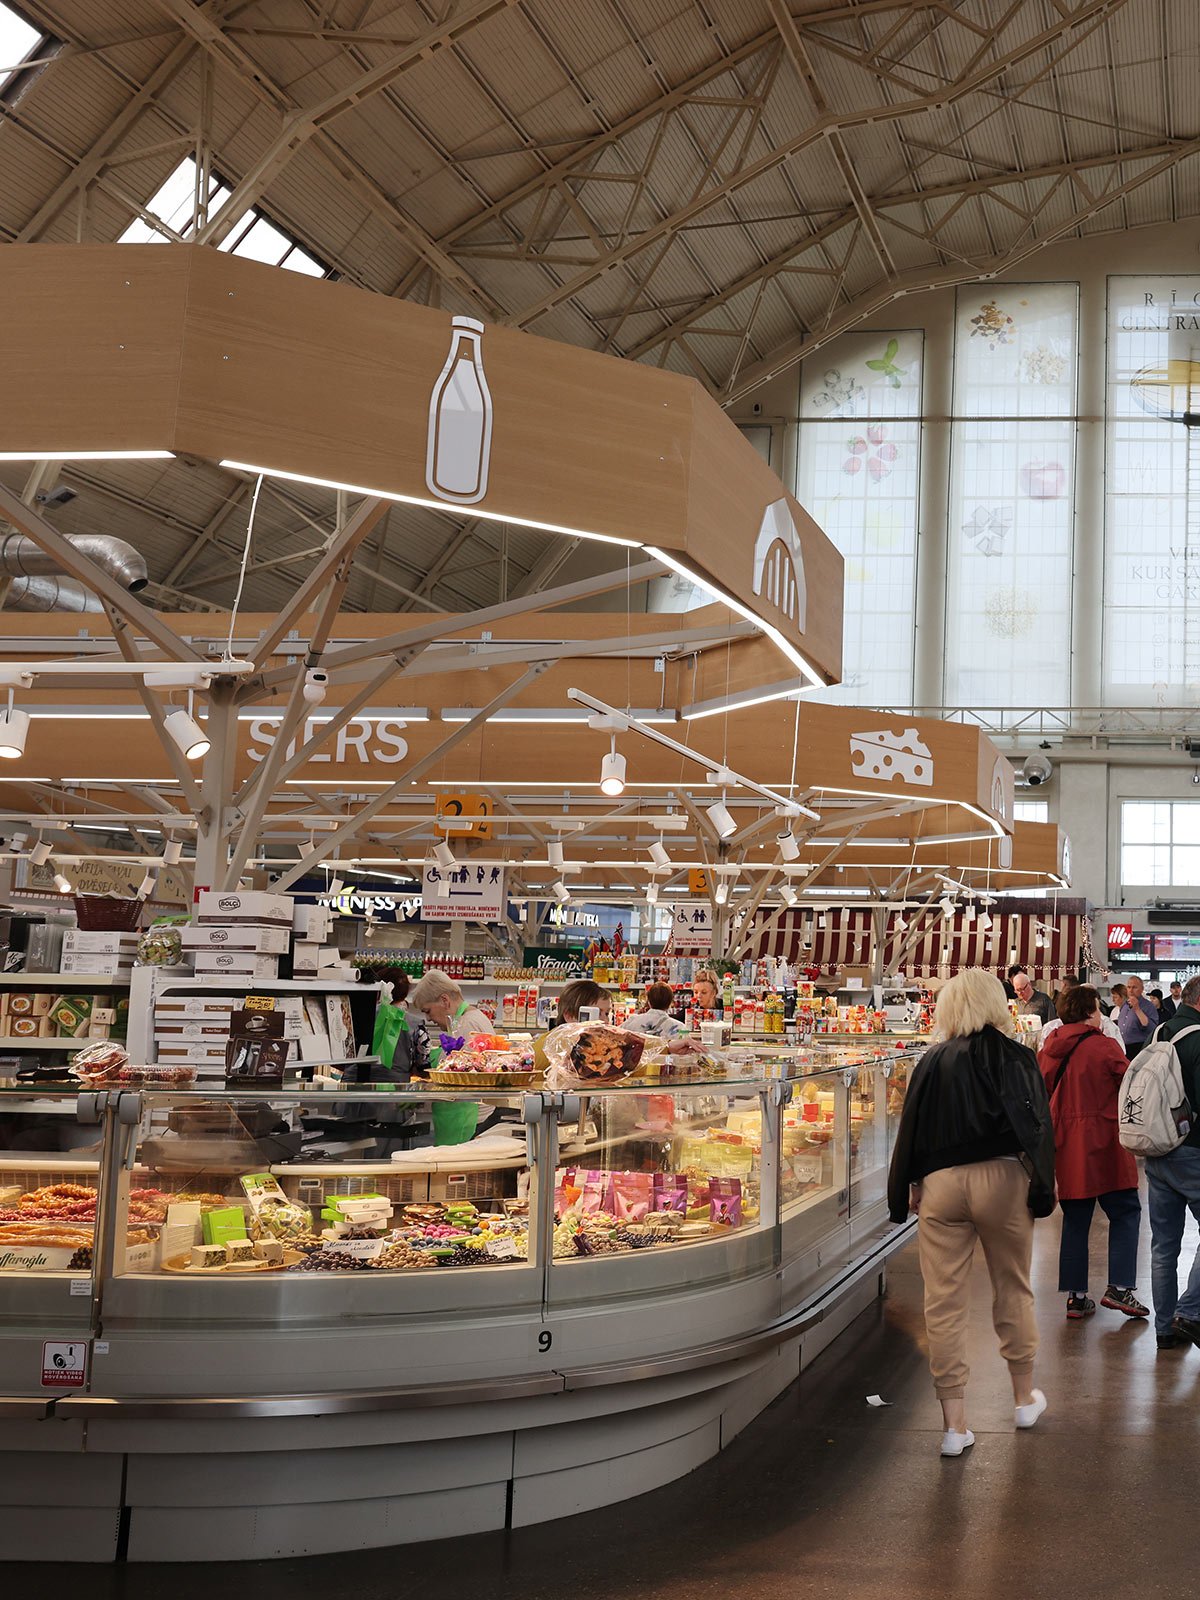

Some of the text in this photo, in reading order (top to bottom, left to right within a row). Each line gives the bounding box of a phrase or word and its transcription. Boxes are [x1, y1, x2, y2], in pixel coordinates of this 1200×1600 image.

[1132, 566, 1171, 580] KUR
[694, 868, 707, 888] 3
[1108, 926, 1132, 948] illy
[0, 1252, 48, 1269] ffaroğlu
[537, 1330, 553, 1354] 9
